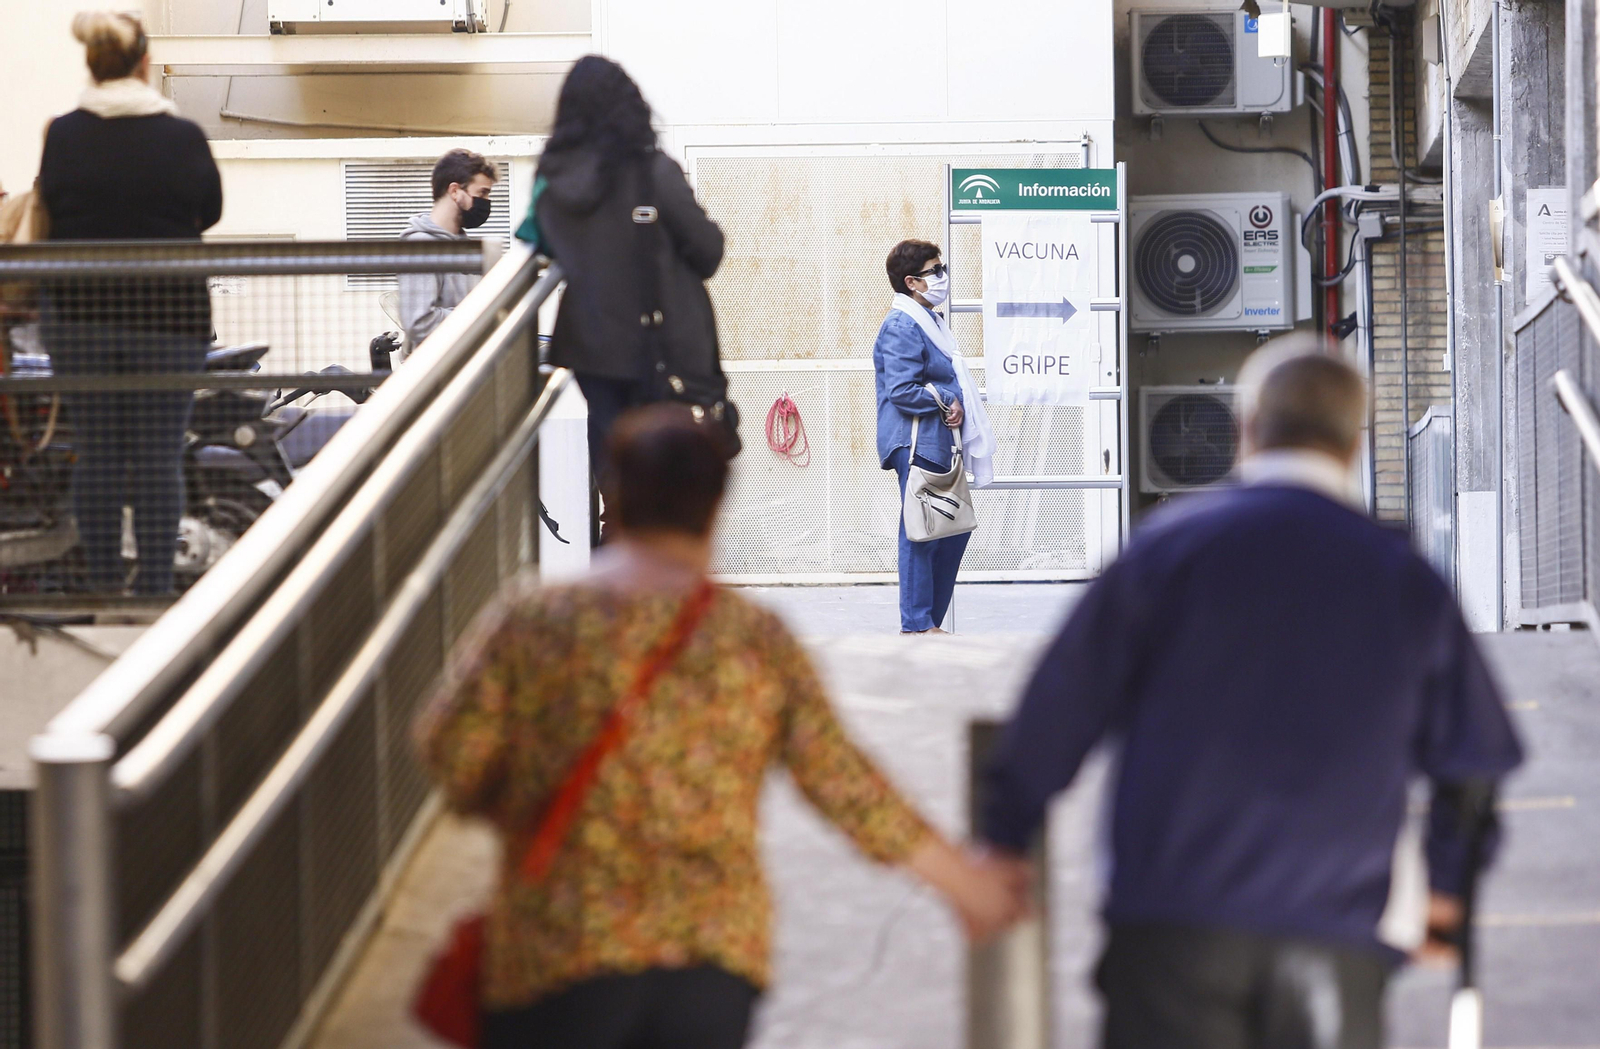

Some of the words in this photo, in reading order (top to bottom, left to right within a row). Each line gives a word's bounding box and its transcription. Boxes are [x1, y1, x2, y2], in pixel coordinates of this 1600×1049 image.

[1018, 183, 1110, 197] Información
[1243, 230, 1278, 241] EAS
[995, 242, 1079, 260] VACUNA
[1244, 307, 1280, 316] Inverter
[1003, 354, 1070, 376] GRIPE
